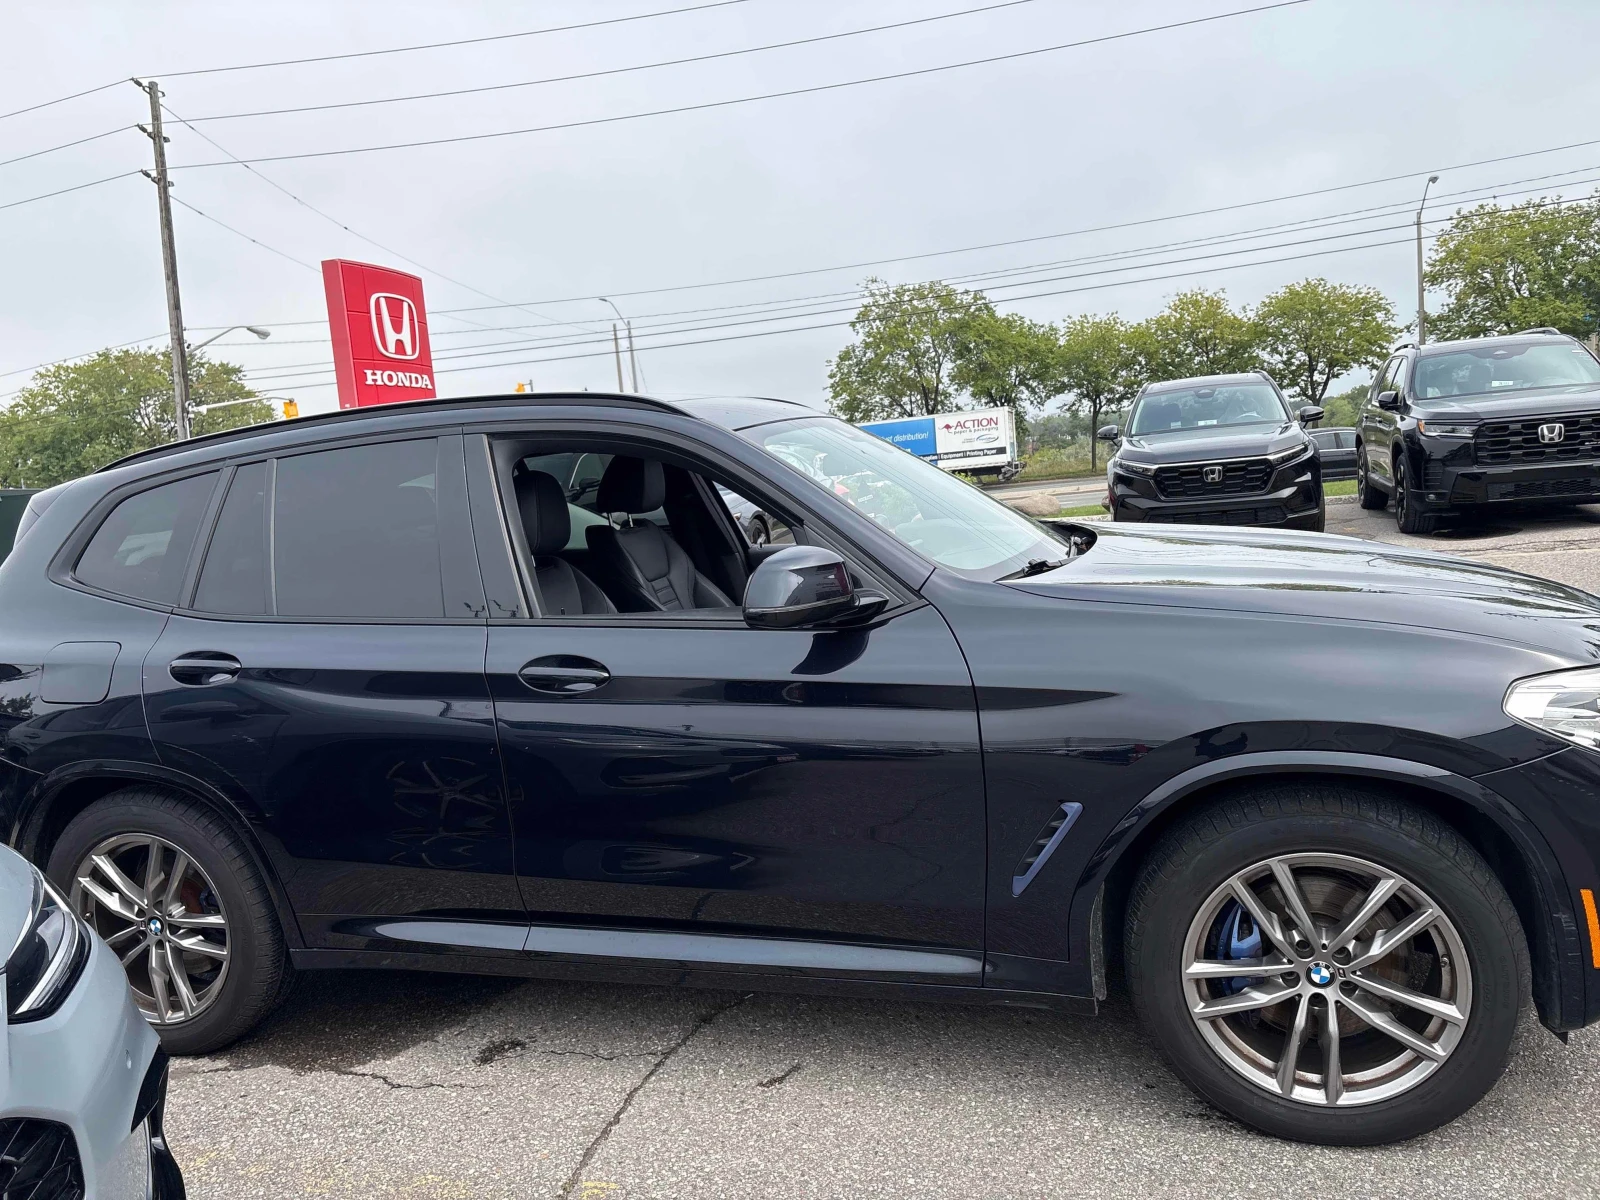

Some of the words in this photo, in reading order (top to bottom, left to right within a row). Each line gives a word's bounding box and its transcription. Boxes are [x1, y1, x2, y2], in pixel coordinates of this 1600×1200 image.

[364, 370, 433, 389] HONDA
[954, 417, 998, 430] ACTION
[894, 432, 929, 442] distribution!
